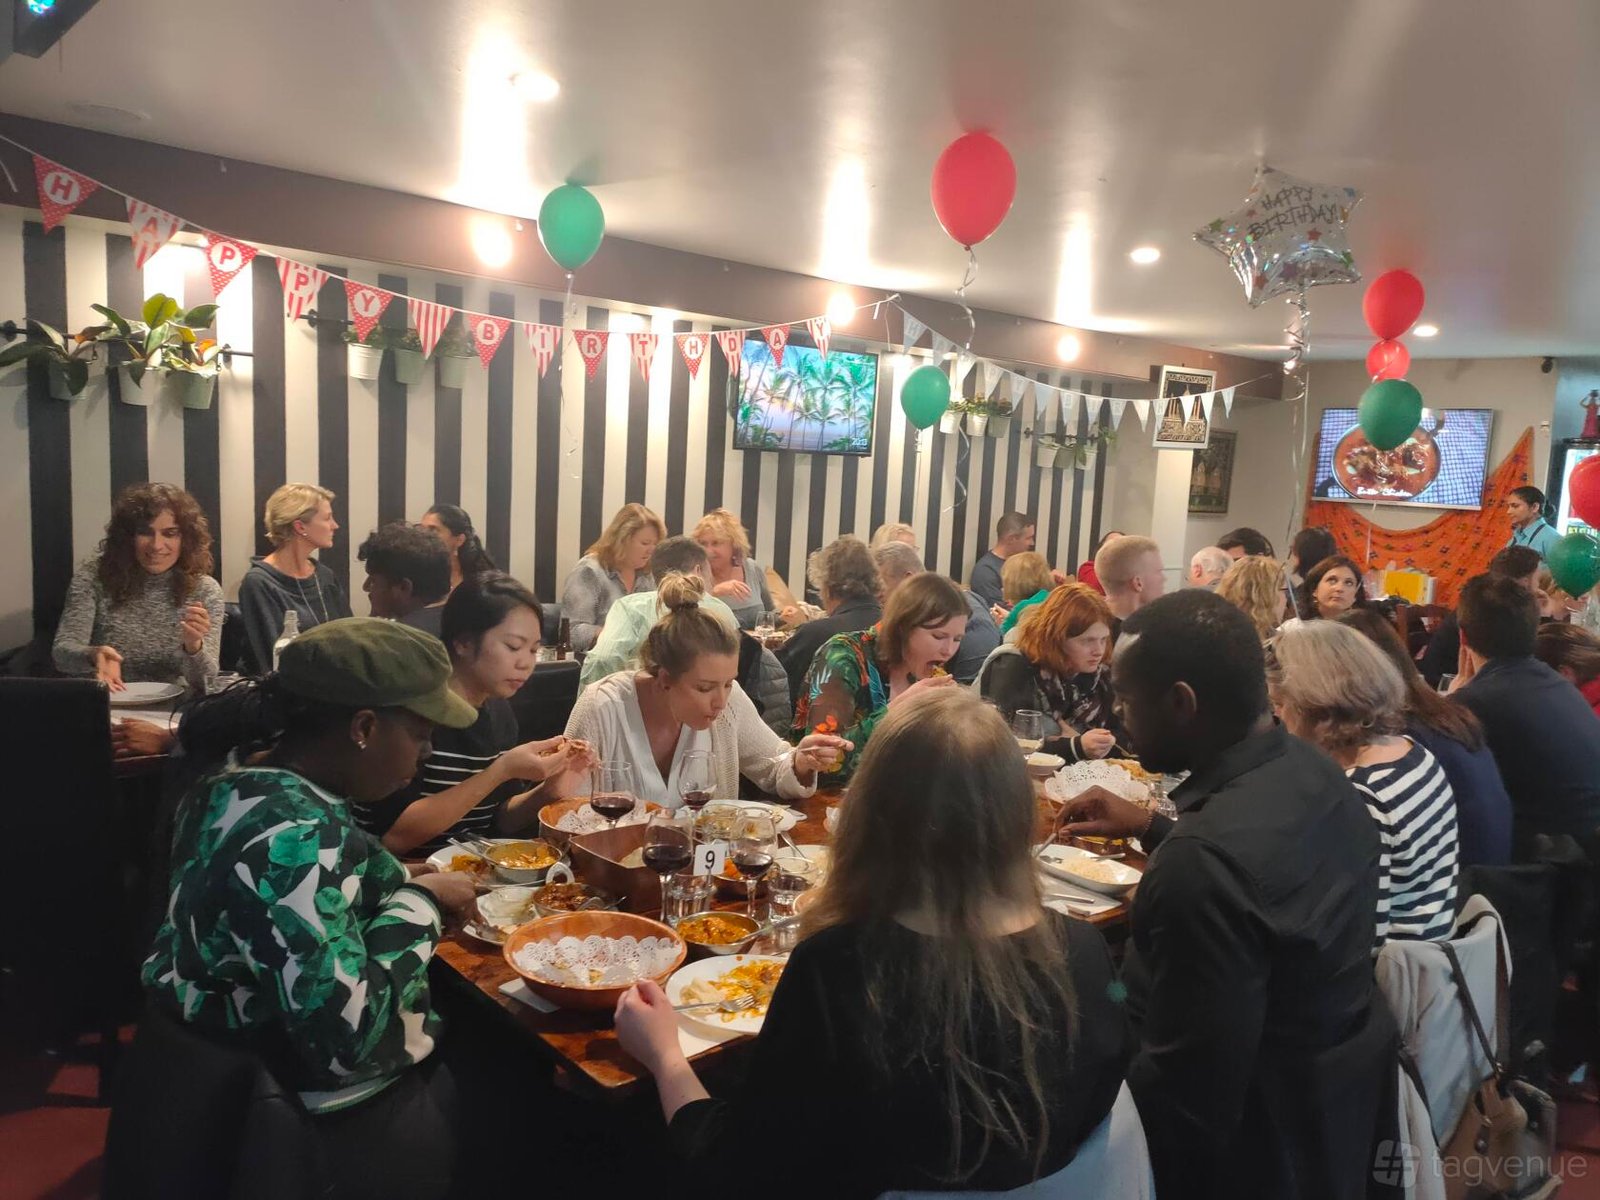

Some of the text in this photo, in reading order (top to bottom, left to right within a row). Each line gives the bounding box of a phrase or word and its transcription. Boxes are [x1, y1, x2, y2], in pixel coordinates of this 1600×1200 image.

[1261, 187, 1313, 211] HAPPY
[52, 173, 823, 356] HAPPY BIRTHDAY
[705, 850, 715, 869] 9
